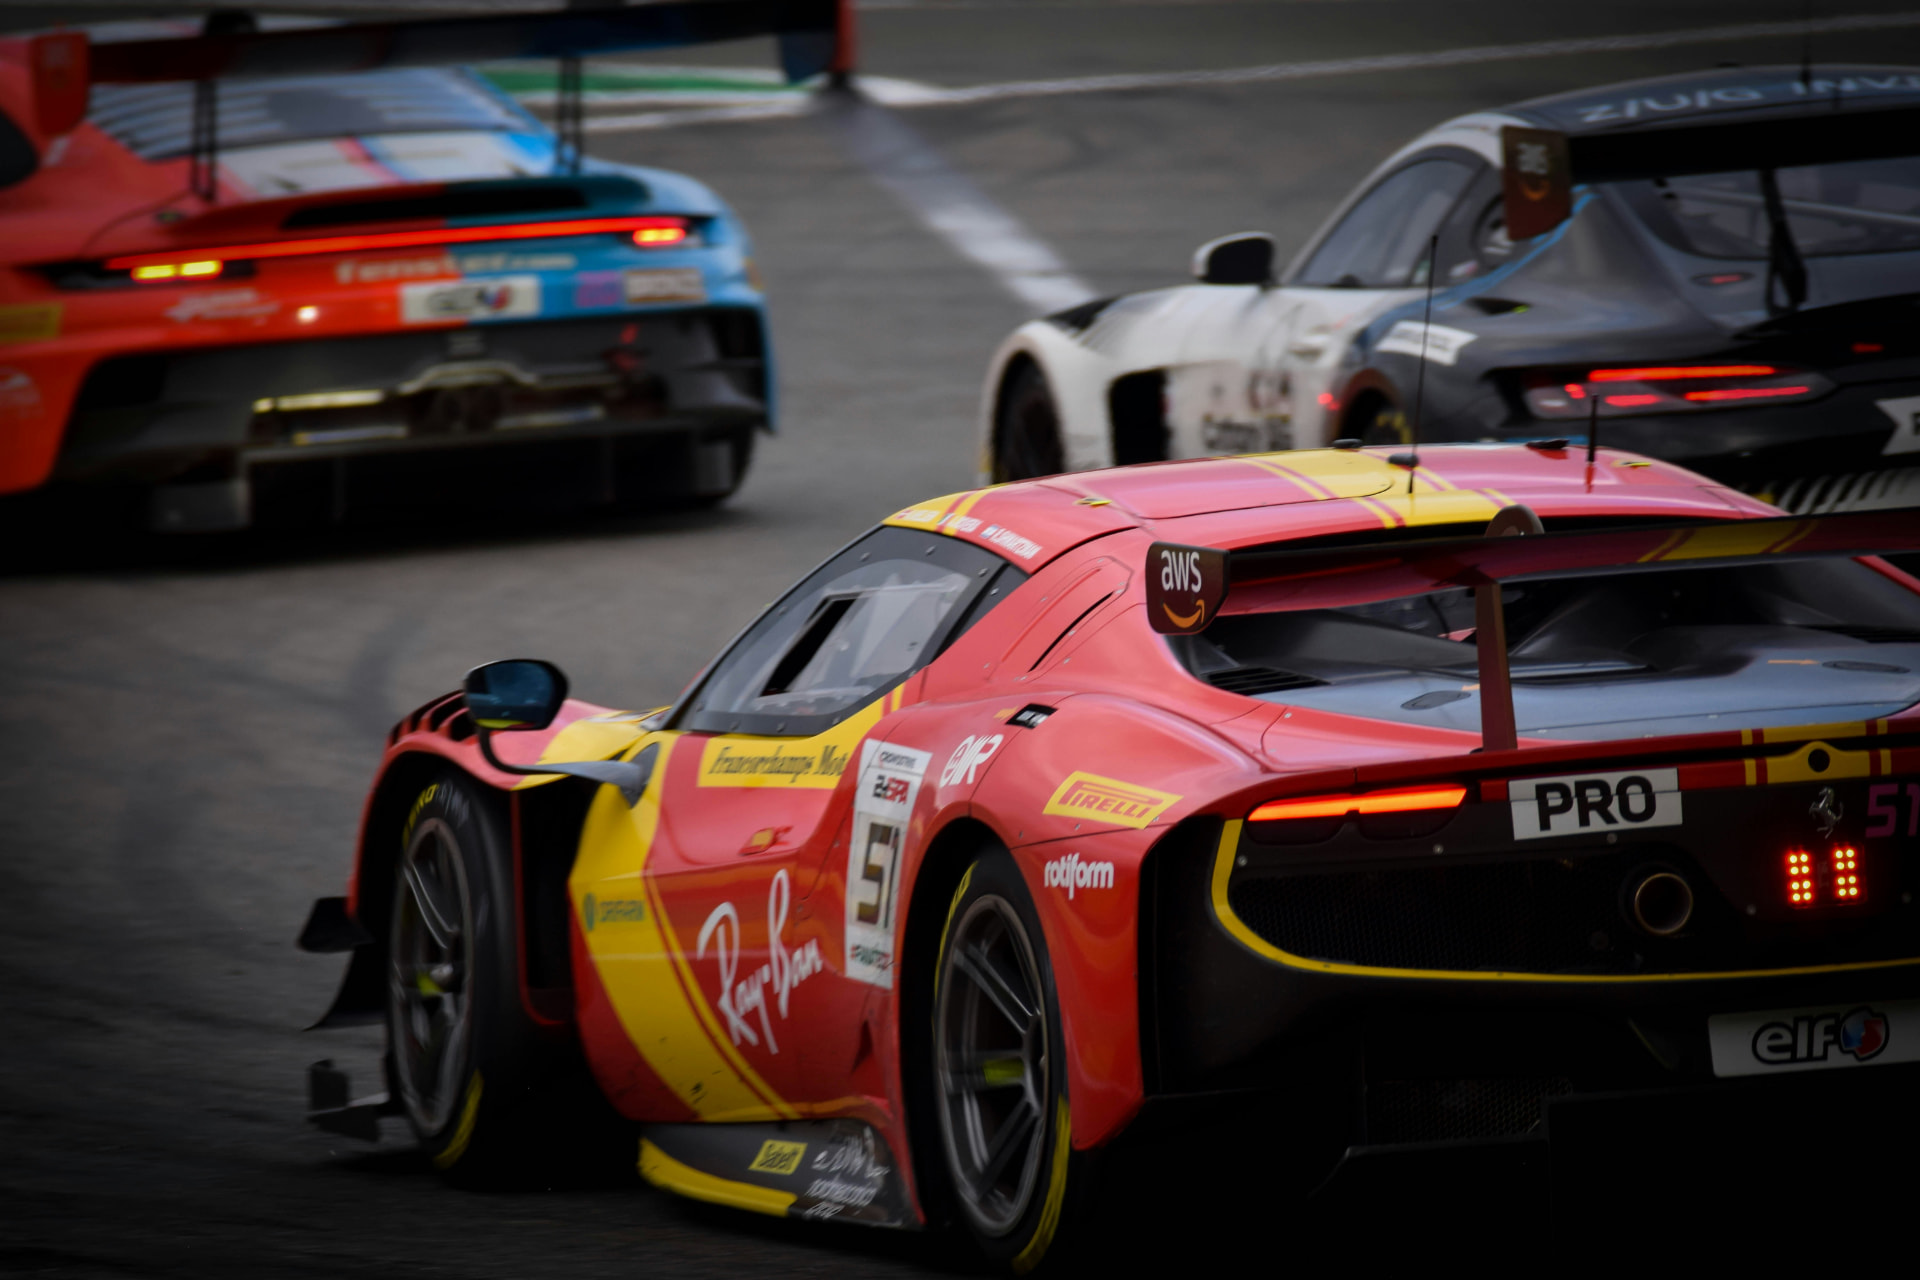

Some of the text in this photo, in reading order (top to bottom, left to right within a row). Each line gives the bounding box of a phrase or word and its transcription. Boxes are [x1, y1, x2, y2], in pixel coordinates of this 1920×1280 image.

[1161, 549, 1202, 593] aws
[1057, 780, 1164, 819] PIRELLI
[1535, 776, 1657, 832] PRO
[1865, 782, 1920, 838] 51
[857, 822, 900, 929] 51
[1044, 852, 1115, 899] rotiform
[1752, 1012, 1841, 1065] elf
